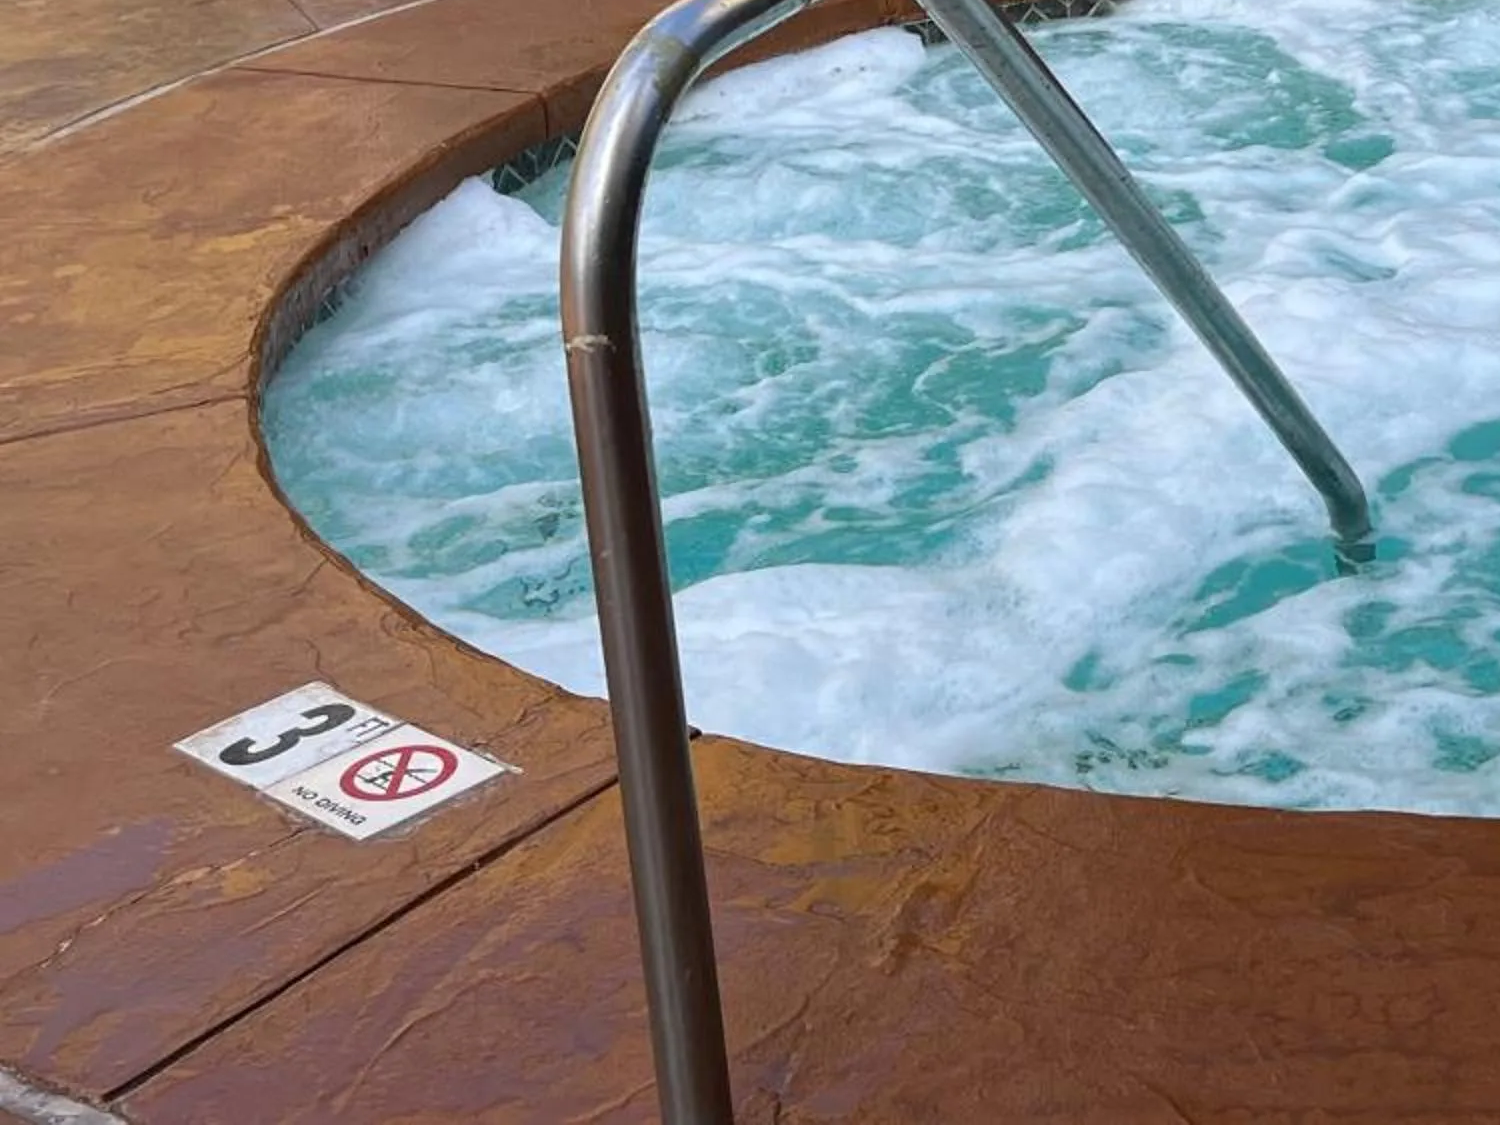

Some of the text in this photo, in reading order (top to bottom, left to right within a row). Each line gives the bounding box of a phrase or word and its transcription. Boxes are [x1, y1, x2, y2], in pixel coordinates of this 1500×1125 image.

[219, 703, 355, 766] 3
[292, 786, 367, 826] NO DIVING
